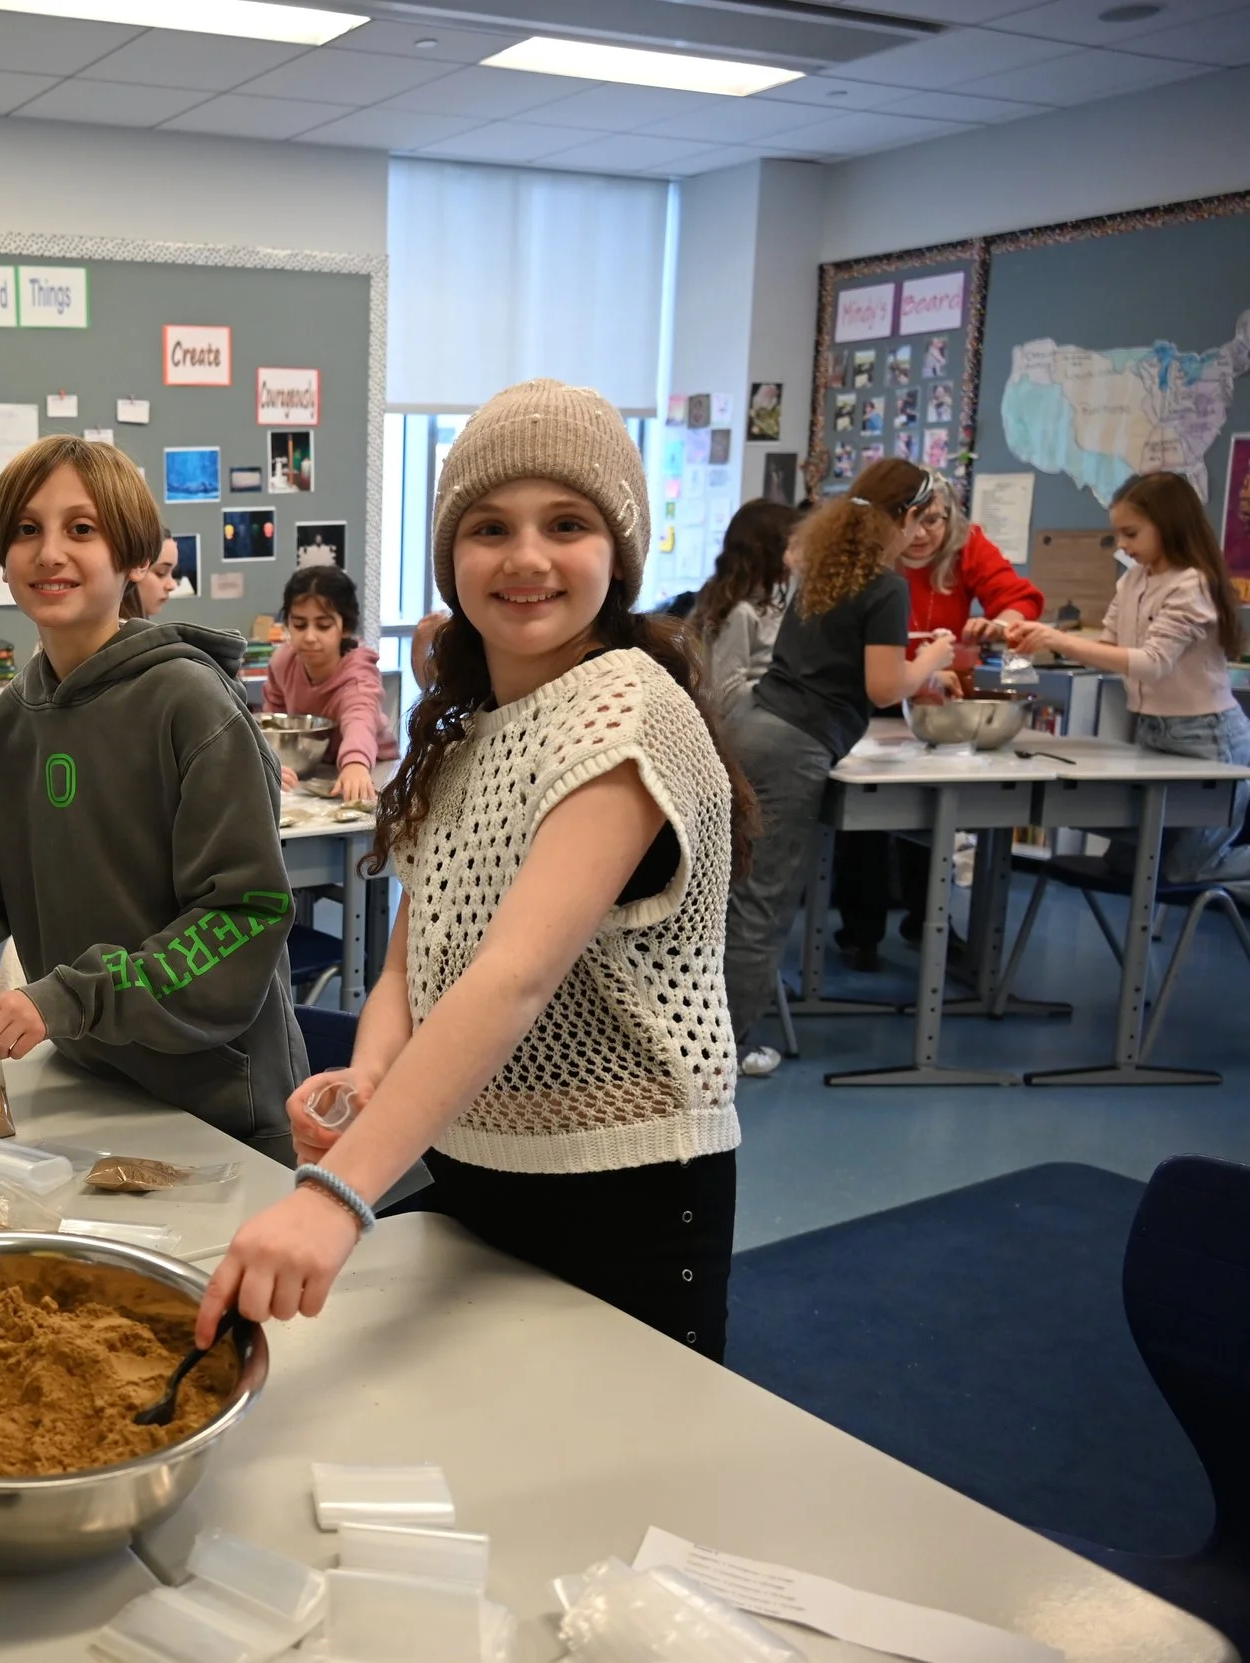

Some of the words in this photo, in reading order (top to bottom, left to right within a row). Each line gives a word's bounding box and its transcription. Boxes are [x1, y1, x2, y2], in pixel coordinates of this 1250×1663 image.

[29, 277, 72, 315] Things
[171, 340, 221, 368] Create
[260, 379, 315, 419] Courageously
[102, 891, 289, 1001] OVERTIE
